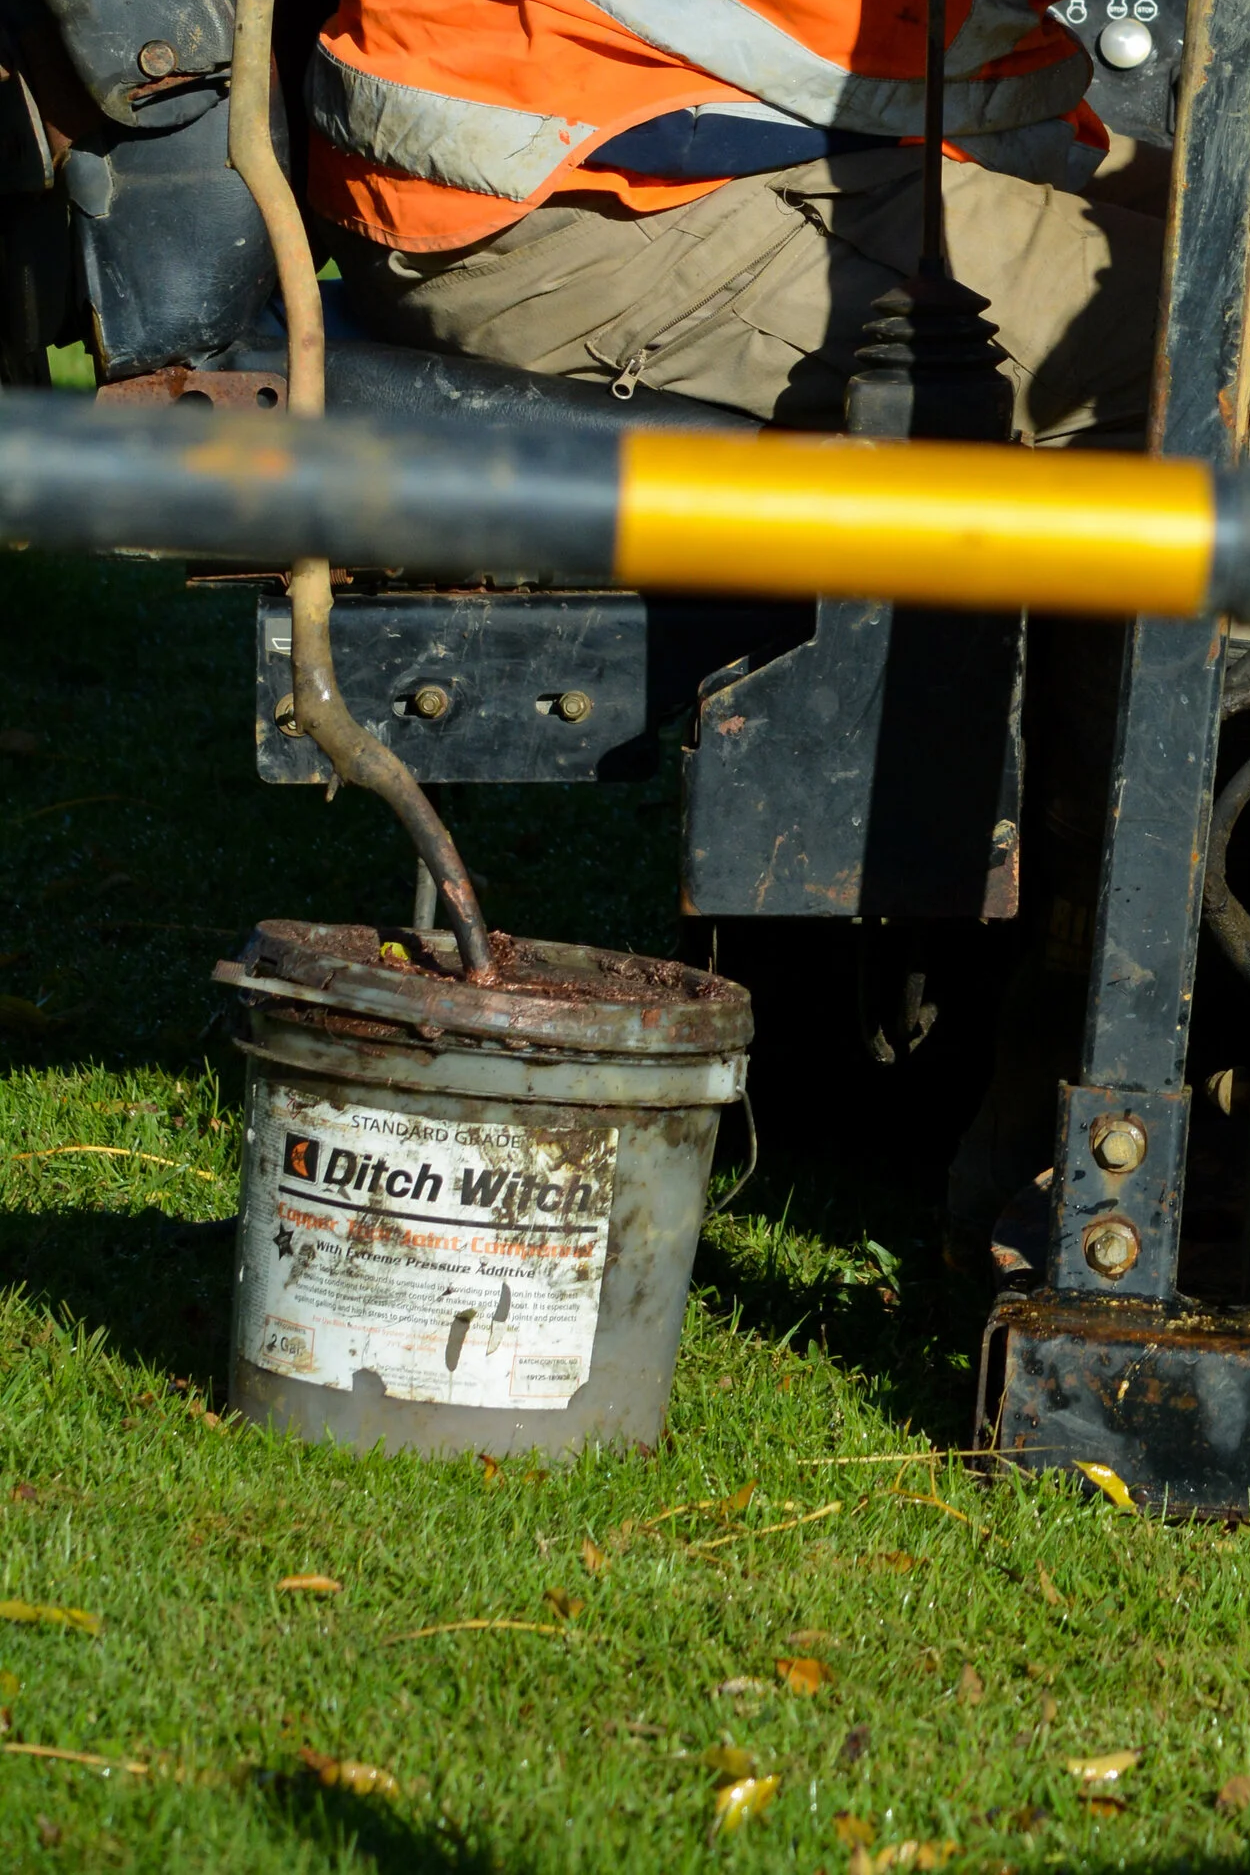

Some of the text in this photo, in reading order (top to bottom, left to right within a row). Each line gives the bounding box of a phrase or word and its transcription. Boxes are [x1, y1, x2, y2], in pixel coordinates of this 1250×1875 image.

[352, 1115, 520, 1149] STANDARD GRADE
[323, 1147, 592, 1213] Ditch Witch
[278, 1201, 339, 1232] Copper
[401, 1228, 462, 1251] Joint
[316, 1240, 536, 1279] With Extreme Pressure Additive
[396, 1279, 435, 1290] unequaled
[534, 1290, 545, 1299] the
[548, 1292, 578, 1302] toughest
[409, 1292, 434, 1303] control
[446, 1296, 477, 1308] makeup
[478, 1300, 490, 1308] and
[547, 1303, 580, 1312] especially
[399, 1314, 429, 1326] prolong
[534, 1314, 547, 1322] and
